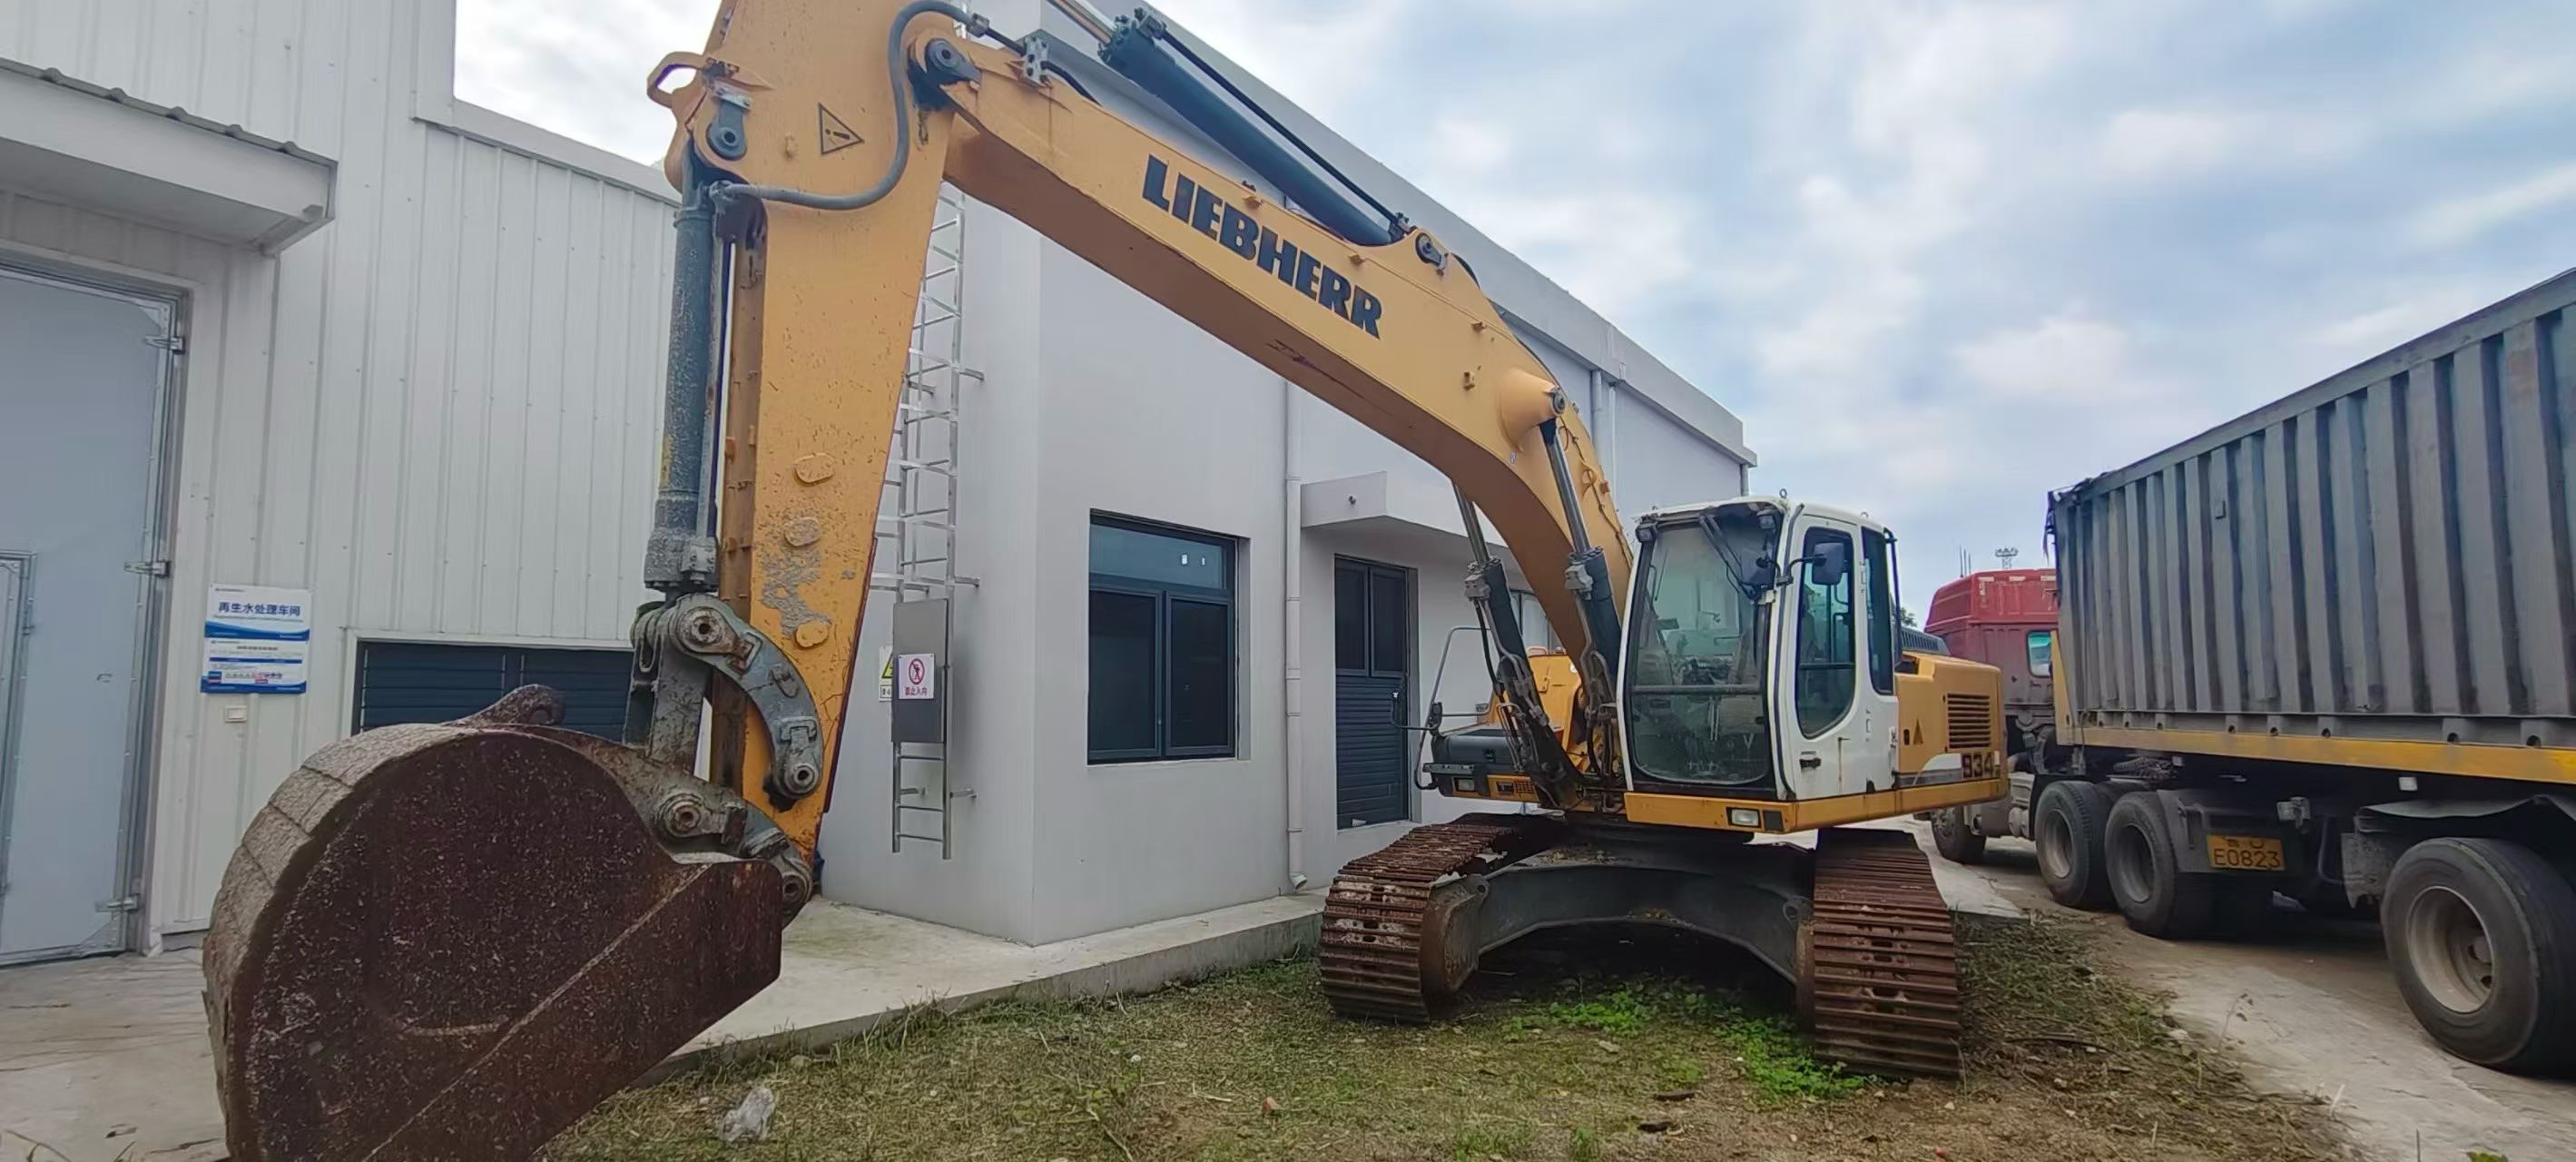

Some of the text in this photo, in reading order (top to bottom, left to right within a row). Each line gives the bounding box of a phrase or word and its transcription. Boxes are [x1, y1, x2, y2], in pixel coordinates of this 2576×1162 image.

[1142, 153, 1381, 340] LIEBHERR
[218, 602, 301, 616] 再生水处理车间
[2214, 848, 2281, 868] E0823
